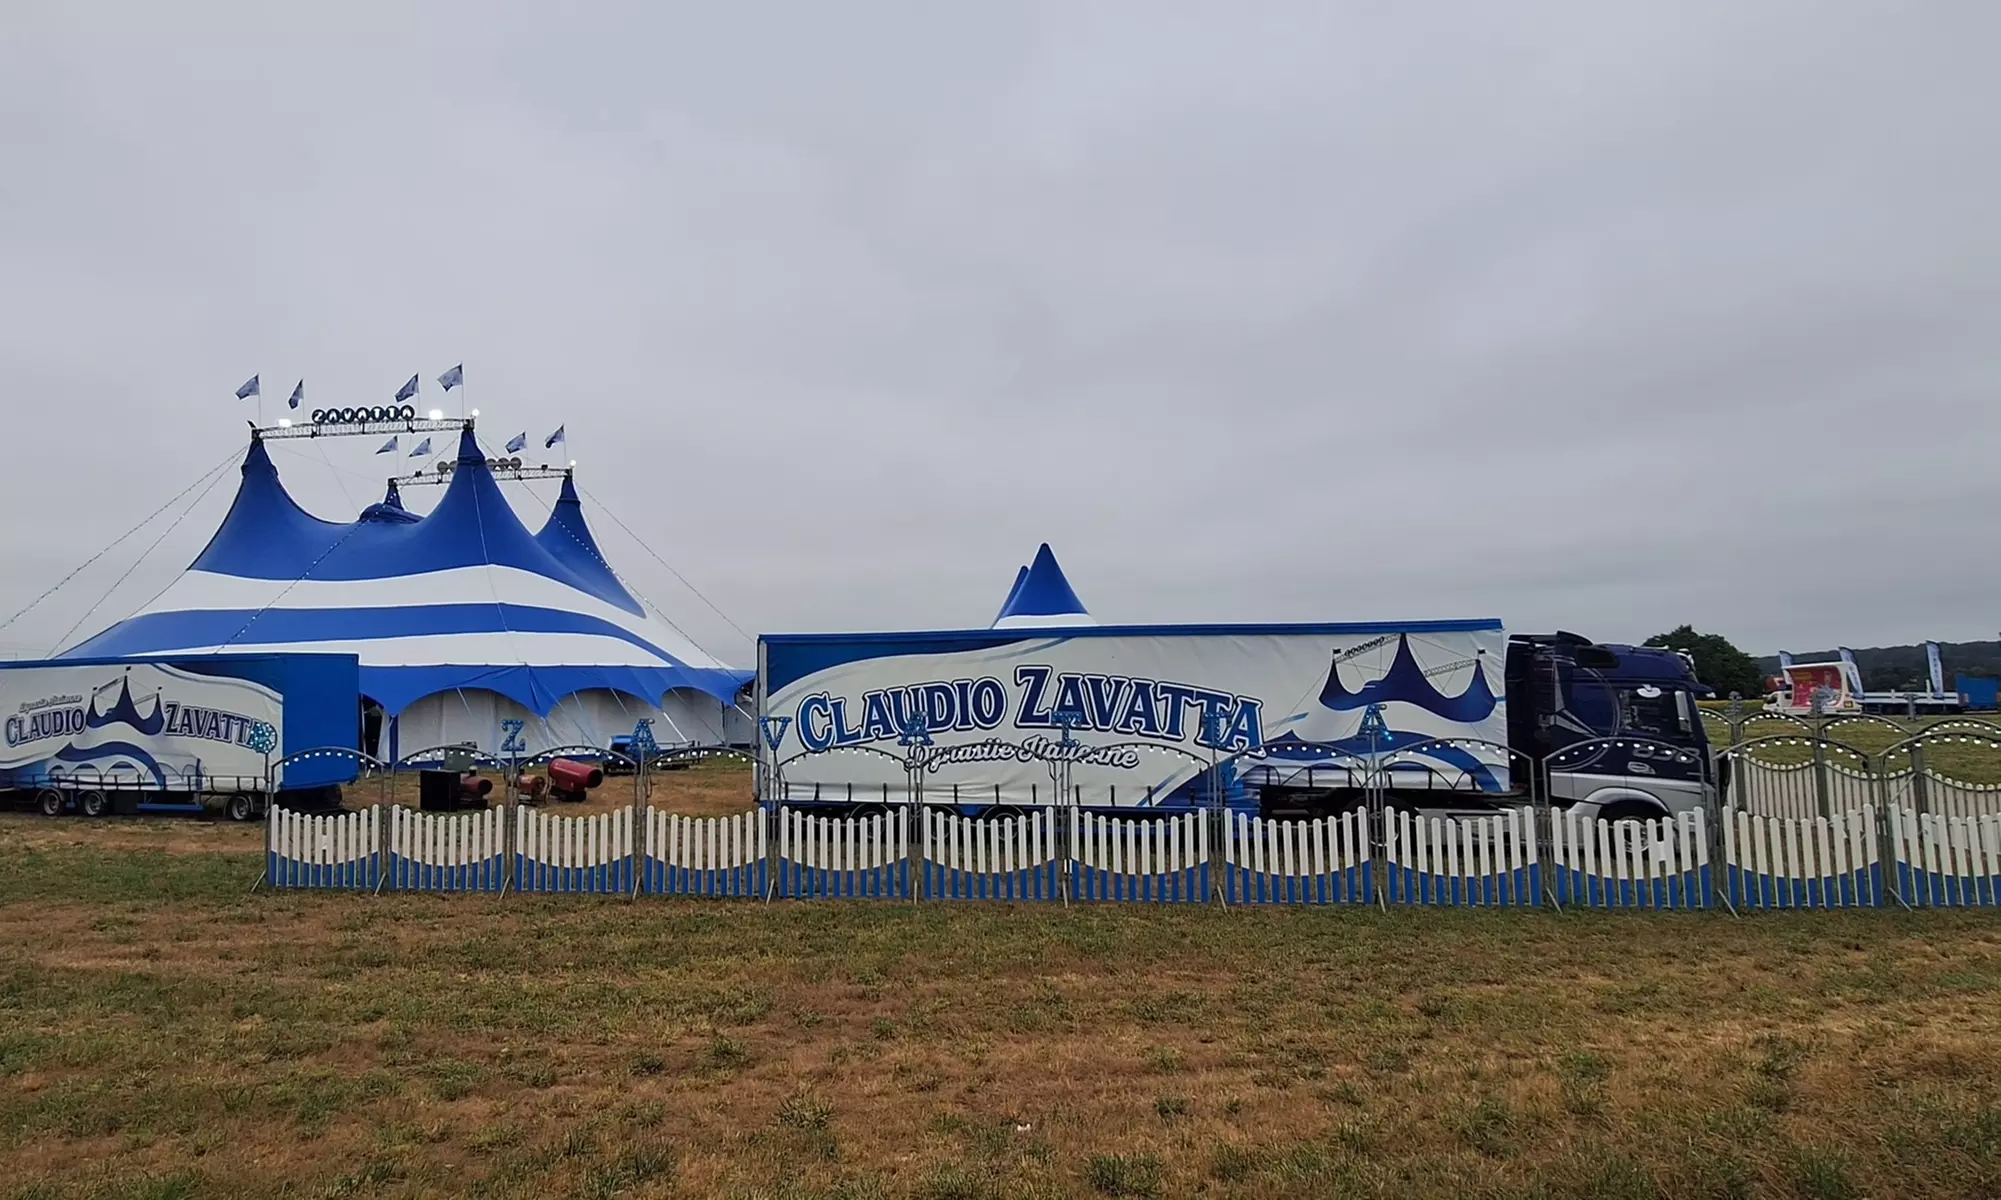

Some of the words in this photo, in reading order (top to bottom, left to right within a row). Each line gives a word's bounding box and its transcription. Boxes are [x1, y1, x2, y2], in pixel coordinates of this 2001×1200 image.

[312, 405, 415, 423] ZAVATTA
[4, 705, 86, 748] CLAUDIO
[164, 701, 266, 750] ZAVATT
[797, 677, 1008, 753] CLAUDIO
[1014, 664, 1266, 758] ZAVATTA
